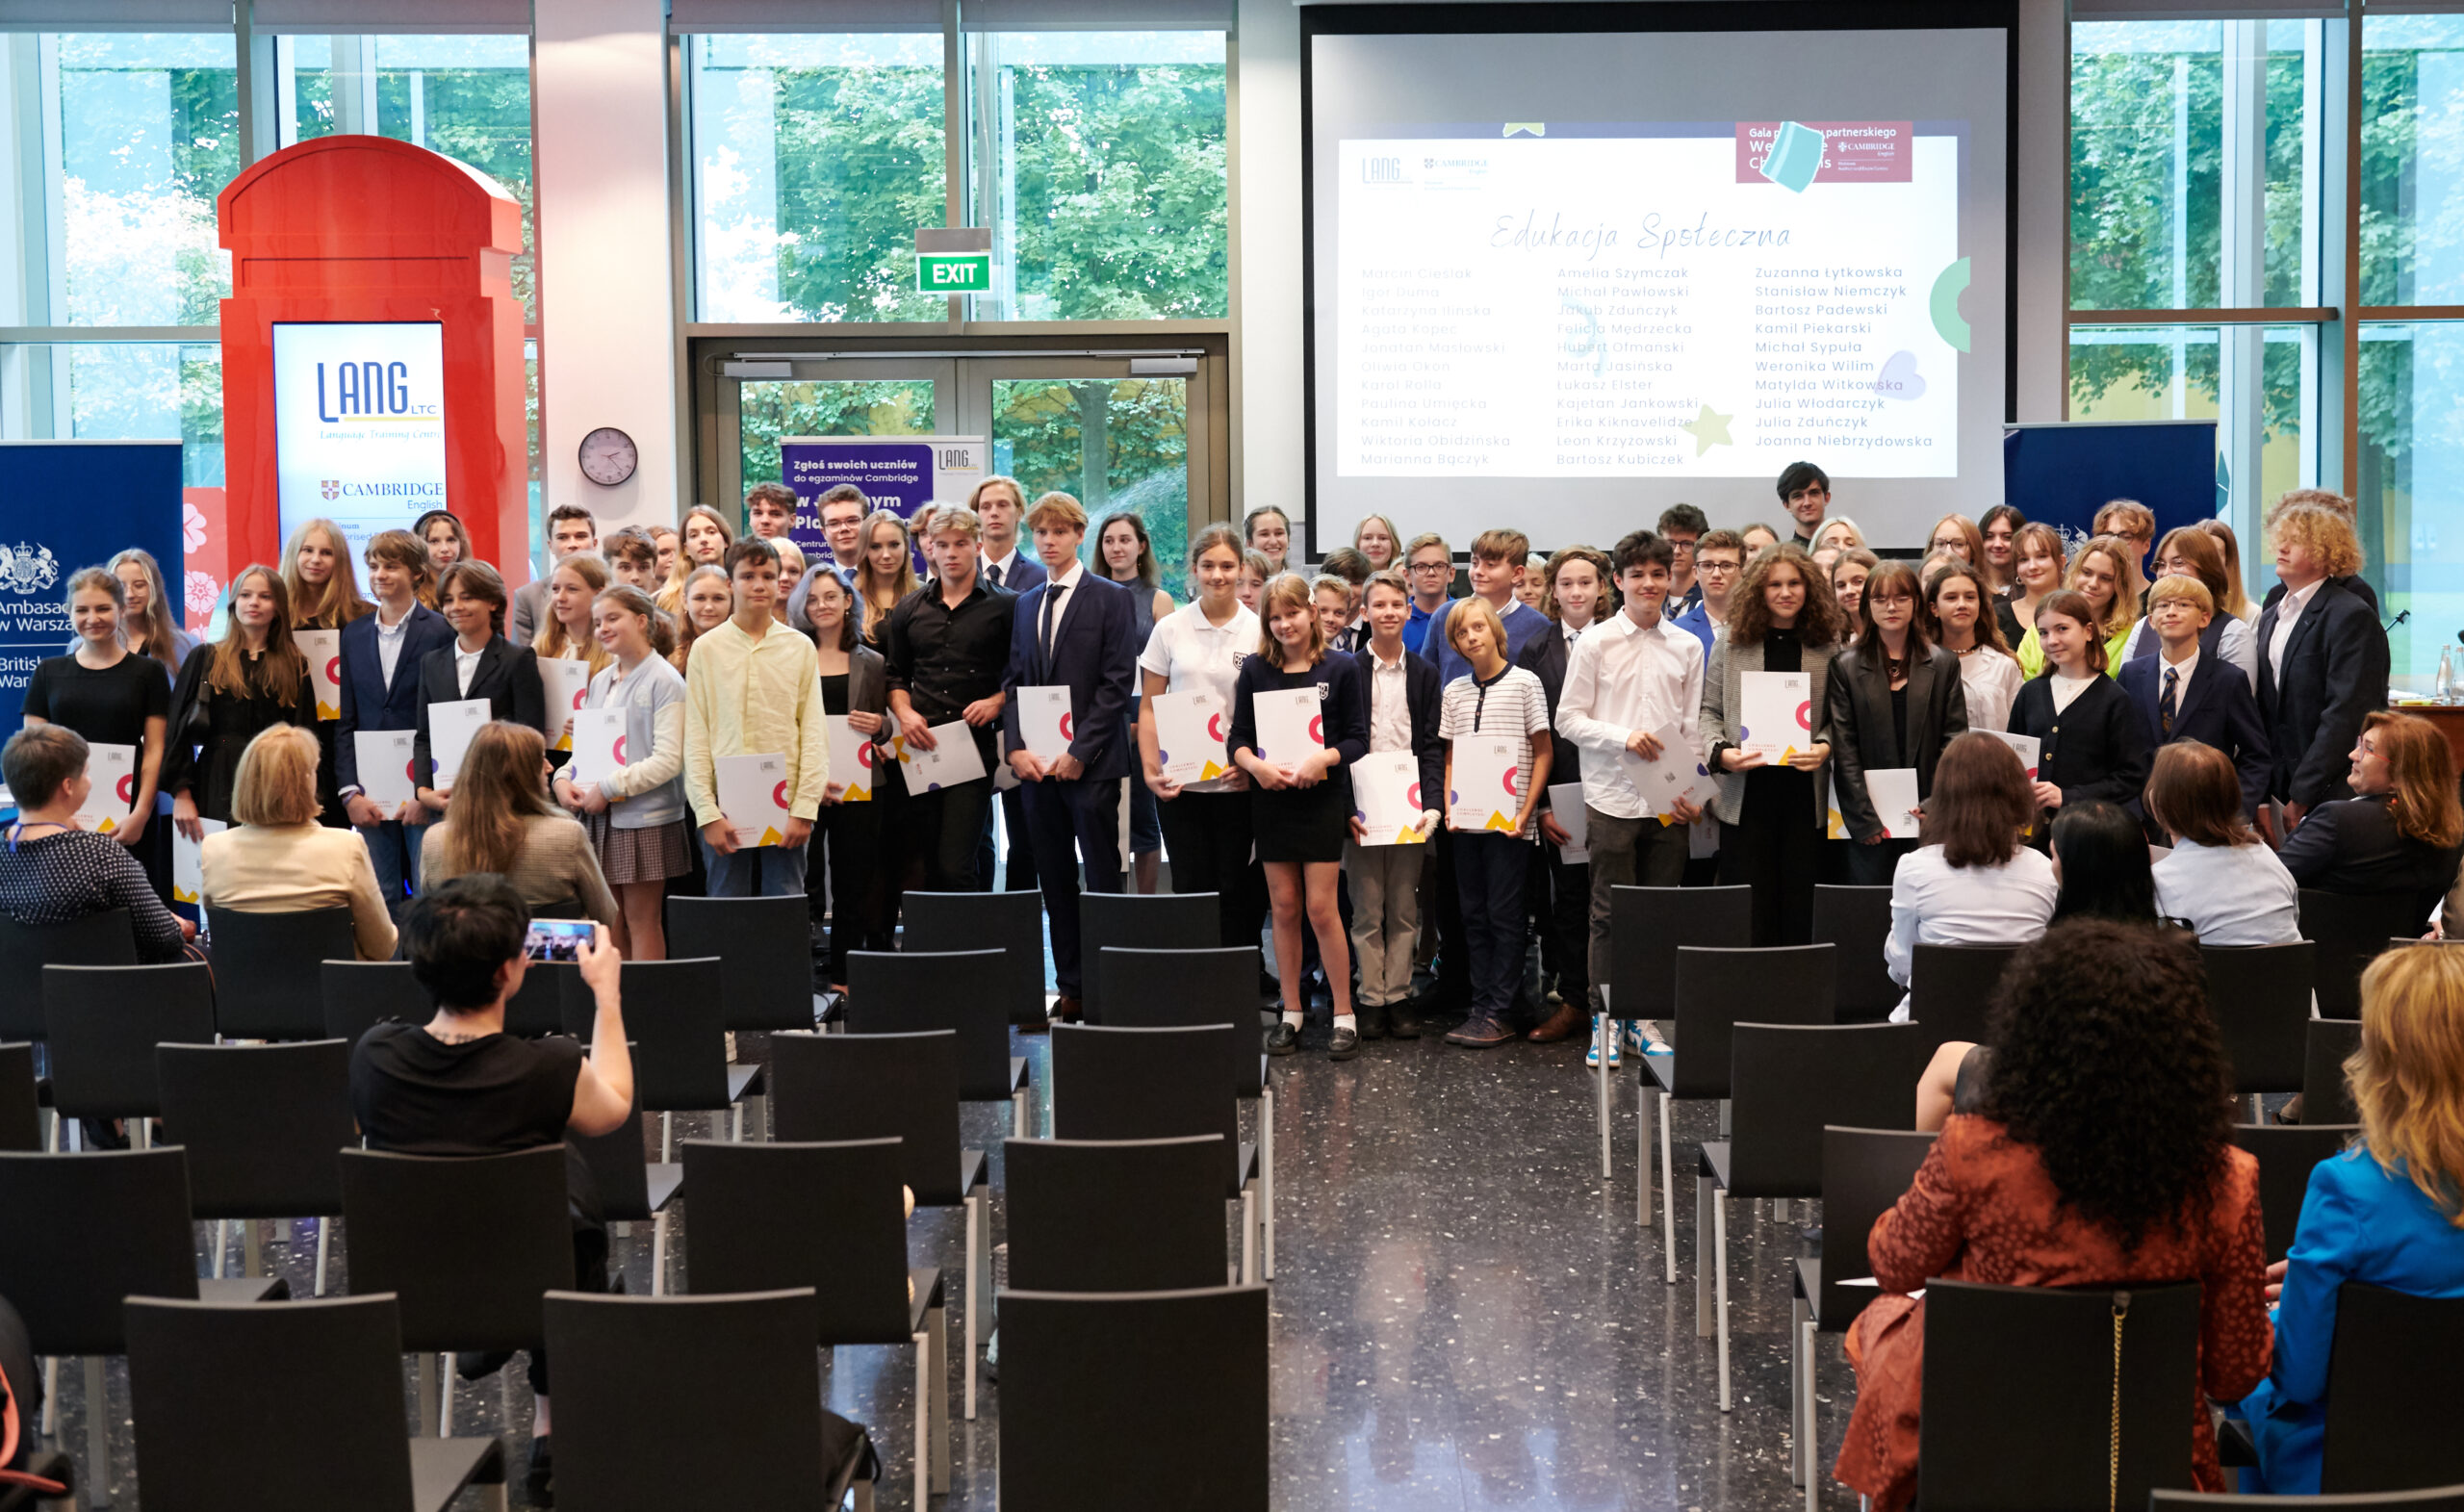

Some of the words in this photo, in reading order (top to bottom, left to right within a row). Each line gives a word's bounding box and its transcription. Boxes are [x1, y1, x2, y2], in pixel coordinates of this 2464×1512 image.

[1749, 127, 1772, 138] Gala
[1826, 126, 1896, 139] partnerskiego
[1491, 209, 1618, 262] Edukacja
[1637, 211, 1790, 260] Społeczna
[933, 263, 977, 283] EXIT
[1558, 268, 1609, 278] Amelia
[1615, 268, 1688, 281] Szymczak
[1755, 268, 1819, 278] Zuzanna
[1613, 287, 1689, 297] Pawłowski
[1755, 286, 1828, 297] Stanisław
[1834, 286, 1906, 299] Niemczyk
[1558, 305, 1602, 315] Jakub
[1755, 305, 1810, 315] Bartosz
[1817, 304, 1887, 315] Padewski
[1558, 324, 1605, 336] Felicja
[1755, 324, 1797, 333] Kamil
[1804, 323, 1871, 333] Piekarski
[1558, 343, 1607, 353] Hubert
[1558, 361, 1601, 371] Marta
[1755, 361, 1825, 371] Weronika
[1832, 361, 1874, 371] Wilim
[1613, 380, 1652, 390] Elster
[1755, 380, 1816, 392] Matylda
[1823, 380, 1903, 390] Witkowska
[318, 362, 408, 423] LANG
[411, 405, 437, 414] LTC
[1362, 399, 1417, 409] Paulina
[1557, 398, 1614, 411] Kajetan
[1621, 398, 1698, 408] Jankowski
[1755, 399, 1791, 409] Julia
[1362, 418, 1403, 427] Kamil
[1557, 417, 1592, 427] Erika
[1599, 417, 1692, 427] Kiknavelidze
[1755, 417, 1791, 427] Julia
[321, 430, 366, 443] Language
[370, 429, 410, 442] Training
[1362, 436, 1422, 446] Wiktoria
[1557, 436, 1590, 446] Leon
[1755, 436, 1811, 446] Joanna
[1818, 436, 1932, 449] Niebrzydowska
[939, 449, 968, 470] LANG
[1362, 454, 1431, 464] Marianna
[1557, 455, 1612, 464] Bartosz
[1618, 454, 1683, 464] Kubiczek
[794, 460, 825, 472] Zgłoś
[828, 460, 867, 469] swoich
[870, 459, 917, 469] uczniów
[808, 474, 862, 484] egzaminów
[865, 474, 919, 484] Cambridge
[343, 482, 444, 496] CAMBRIDGE
[407, 500, 443, 512] English
[796, 496, 809, 508] w
[0, 600, 69, 615] Ambasa
[16, 618, 74, 631] Warsza
